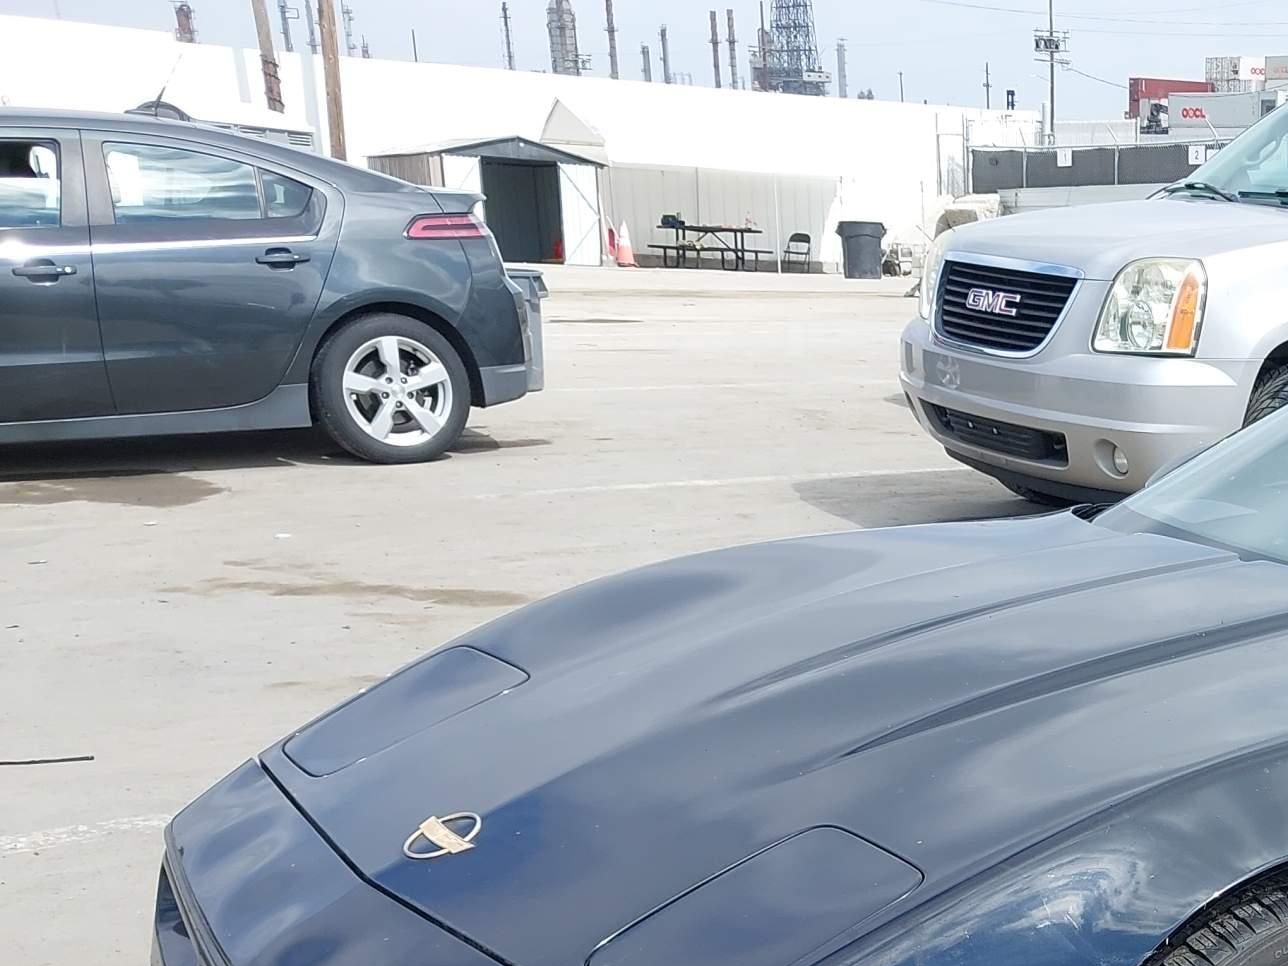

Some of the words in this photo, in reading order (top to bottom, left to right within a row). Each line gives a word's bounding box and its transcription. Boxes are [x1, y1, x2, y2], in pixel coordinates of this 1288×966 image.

[1182, 108, 1206, 119] OOCL
[1194, 150, 1200, 160] 2
[966, 288, 1021, 316] GMC
